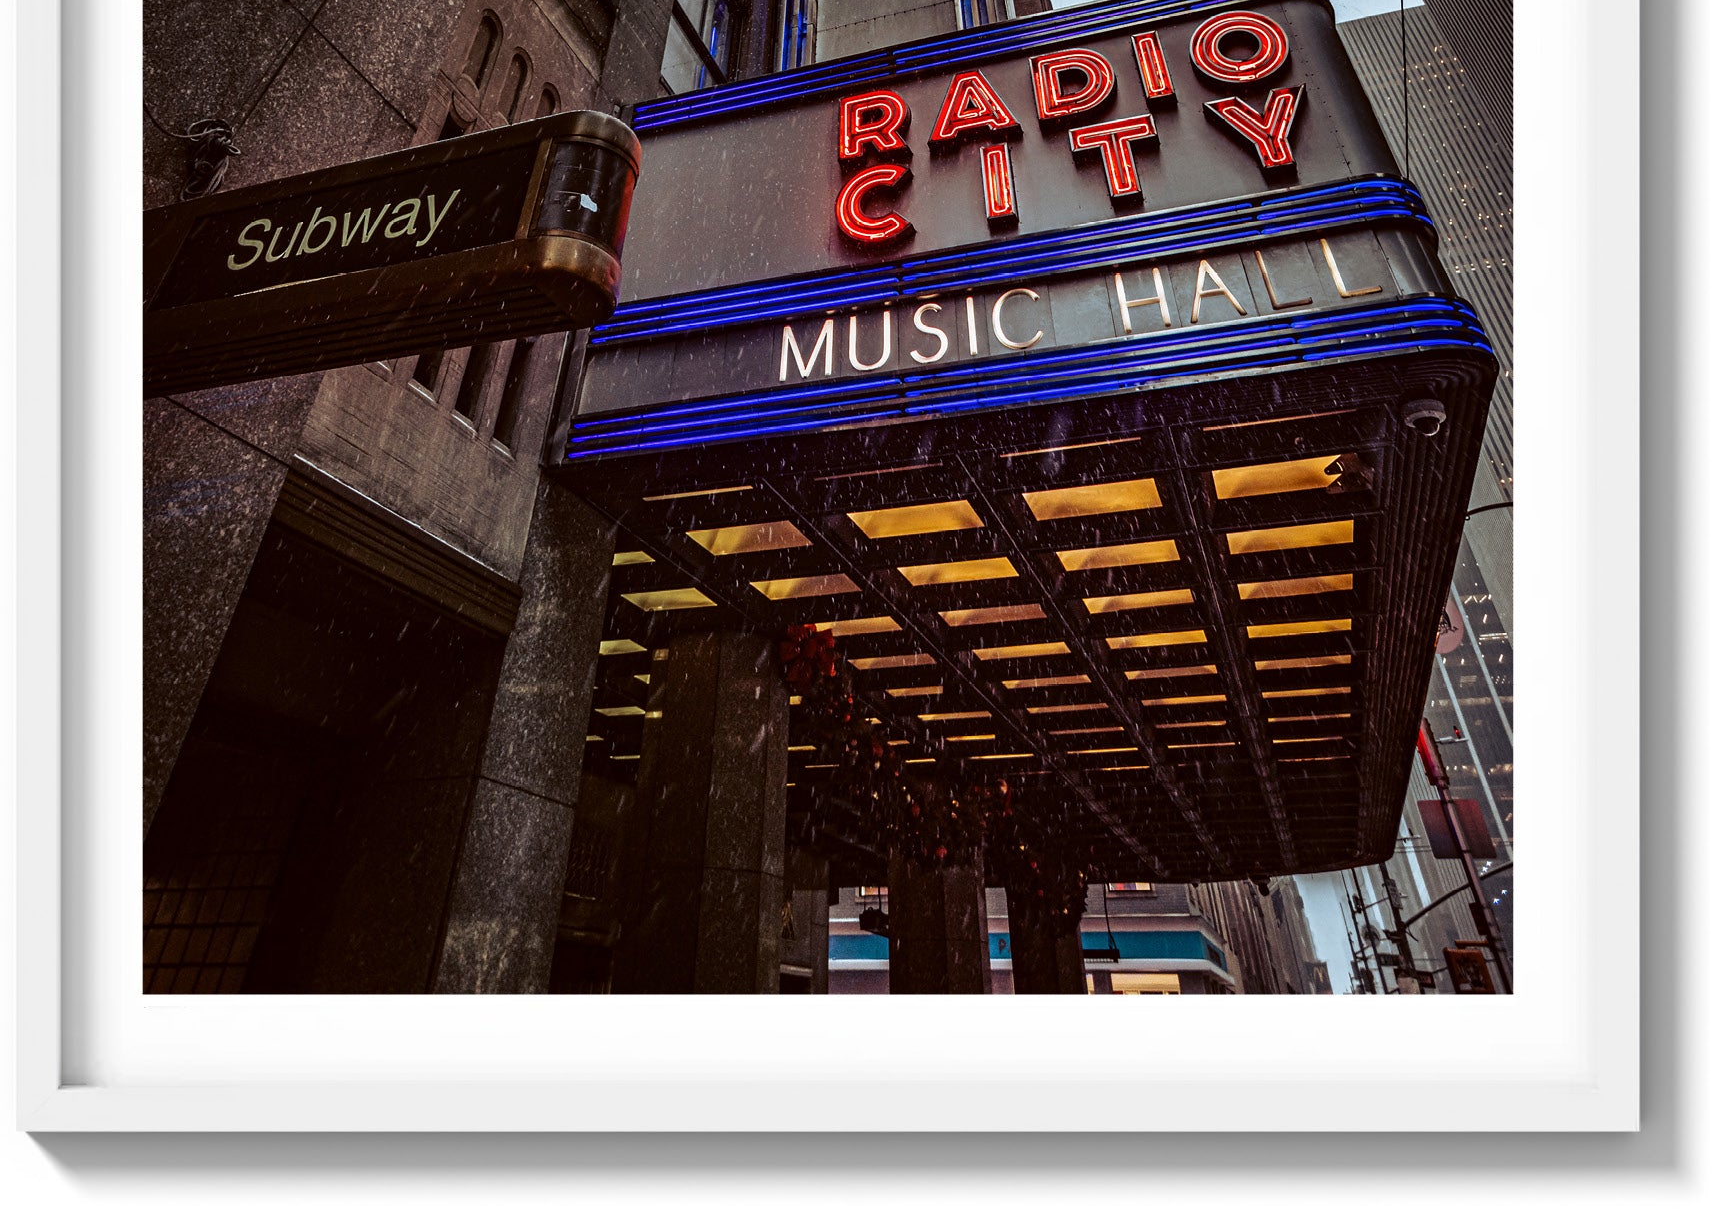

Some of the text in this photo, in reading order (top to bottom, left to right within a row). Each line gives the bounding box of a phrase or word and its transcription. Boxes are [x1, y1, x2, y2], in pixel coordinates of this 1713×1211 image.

[838, 10, 1290, 162] RADIO
[226, 188, 461, 271] Subway
[835, 83, 1306, 246] CITY
[779, 238, 1384, 382] MUSIC HALL
